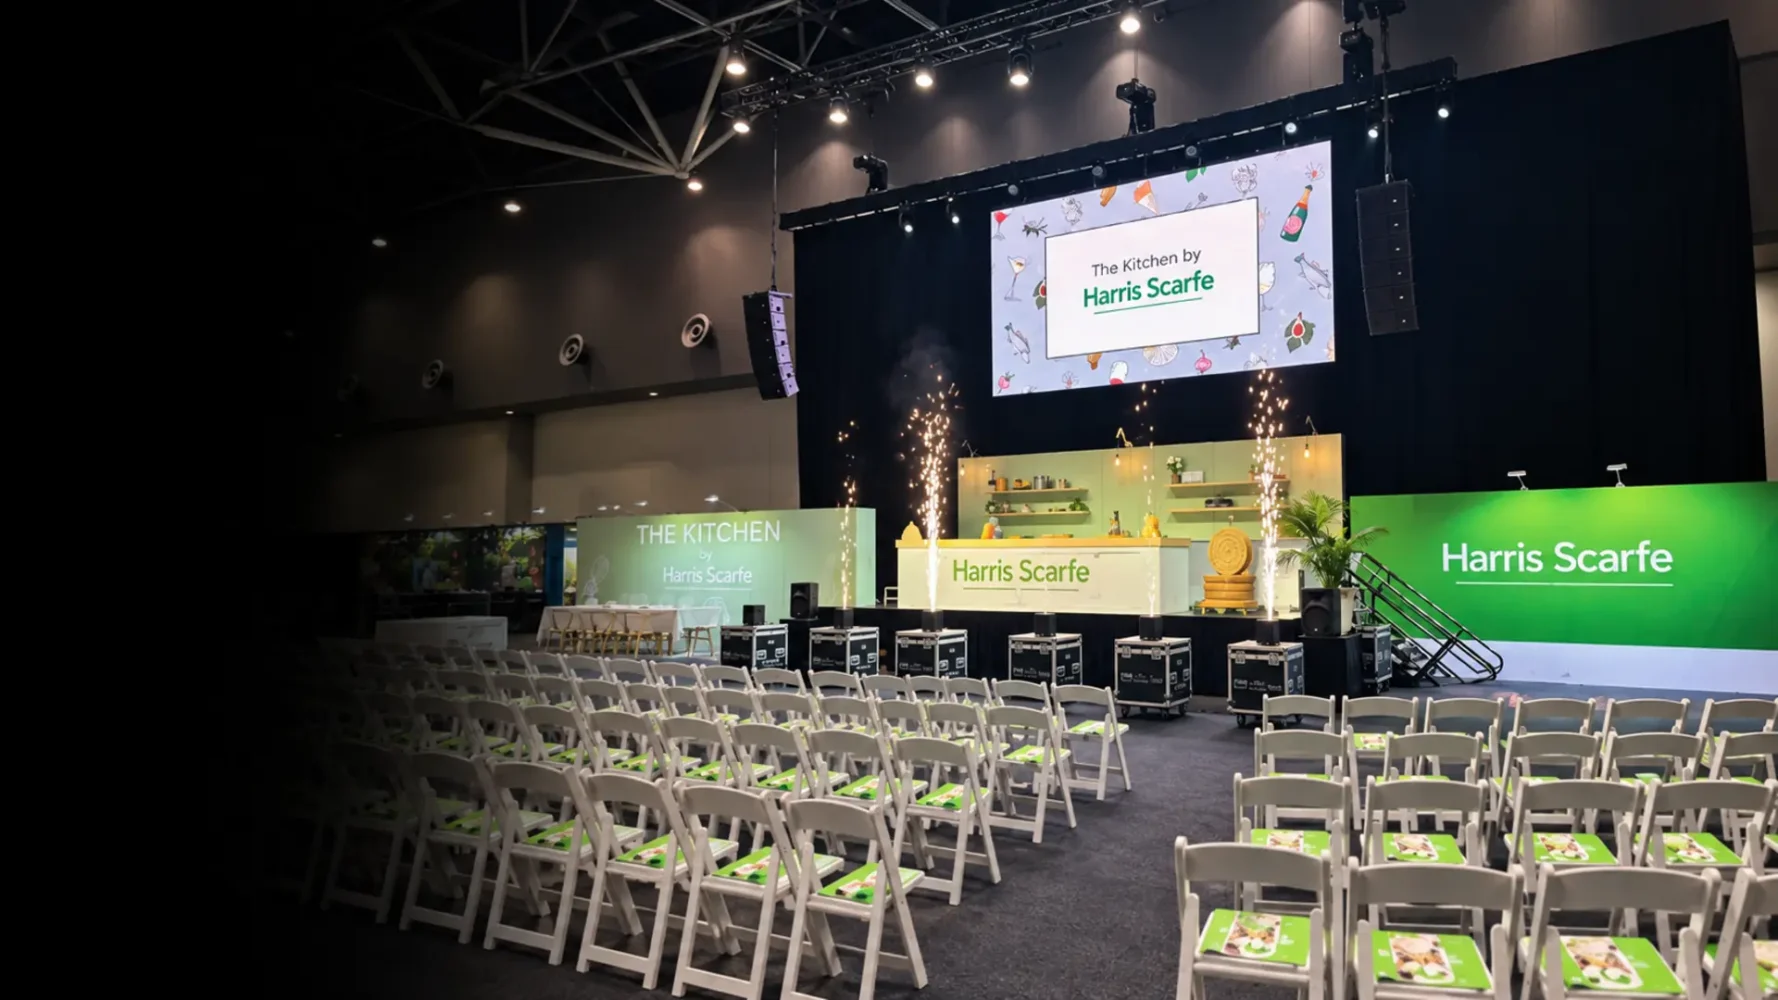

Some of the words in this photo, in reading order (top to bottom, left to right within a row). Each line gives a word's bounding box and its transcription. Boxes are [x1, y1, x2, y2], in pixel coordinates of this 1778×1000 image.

[1092, 263, 1118, 277] The
[1123, 254, 1178, 273] Kitchen
[1183, 249, 1202, 265] by
[1083, 281, 1142, 308] Harris
[1147, 270, 1214, 298] Scarfe
[637, 524, 676, 545] THE
[683, 520, 781, 544] KITCHEN
[699, 550, 713, 562] by
[1442, 542, 1544, 572] Harris
[1554, 540, 1674, 573] Scarfe
[663, 567, 702, 584] Harris
[706, 566, 752, 584] Scarfe
[953, 559, 1013, 582] Harris
[1019, 558, 1090, 583] Scarfe
